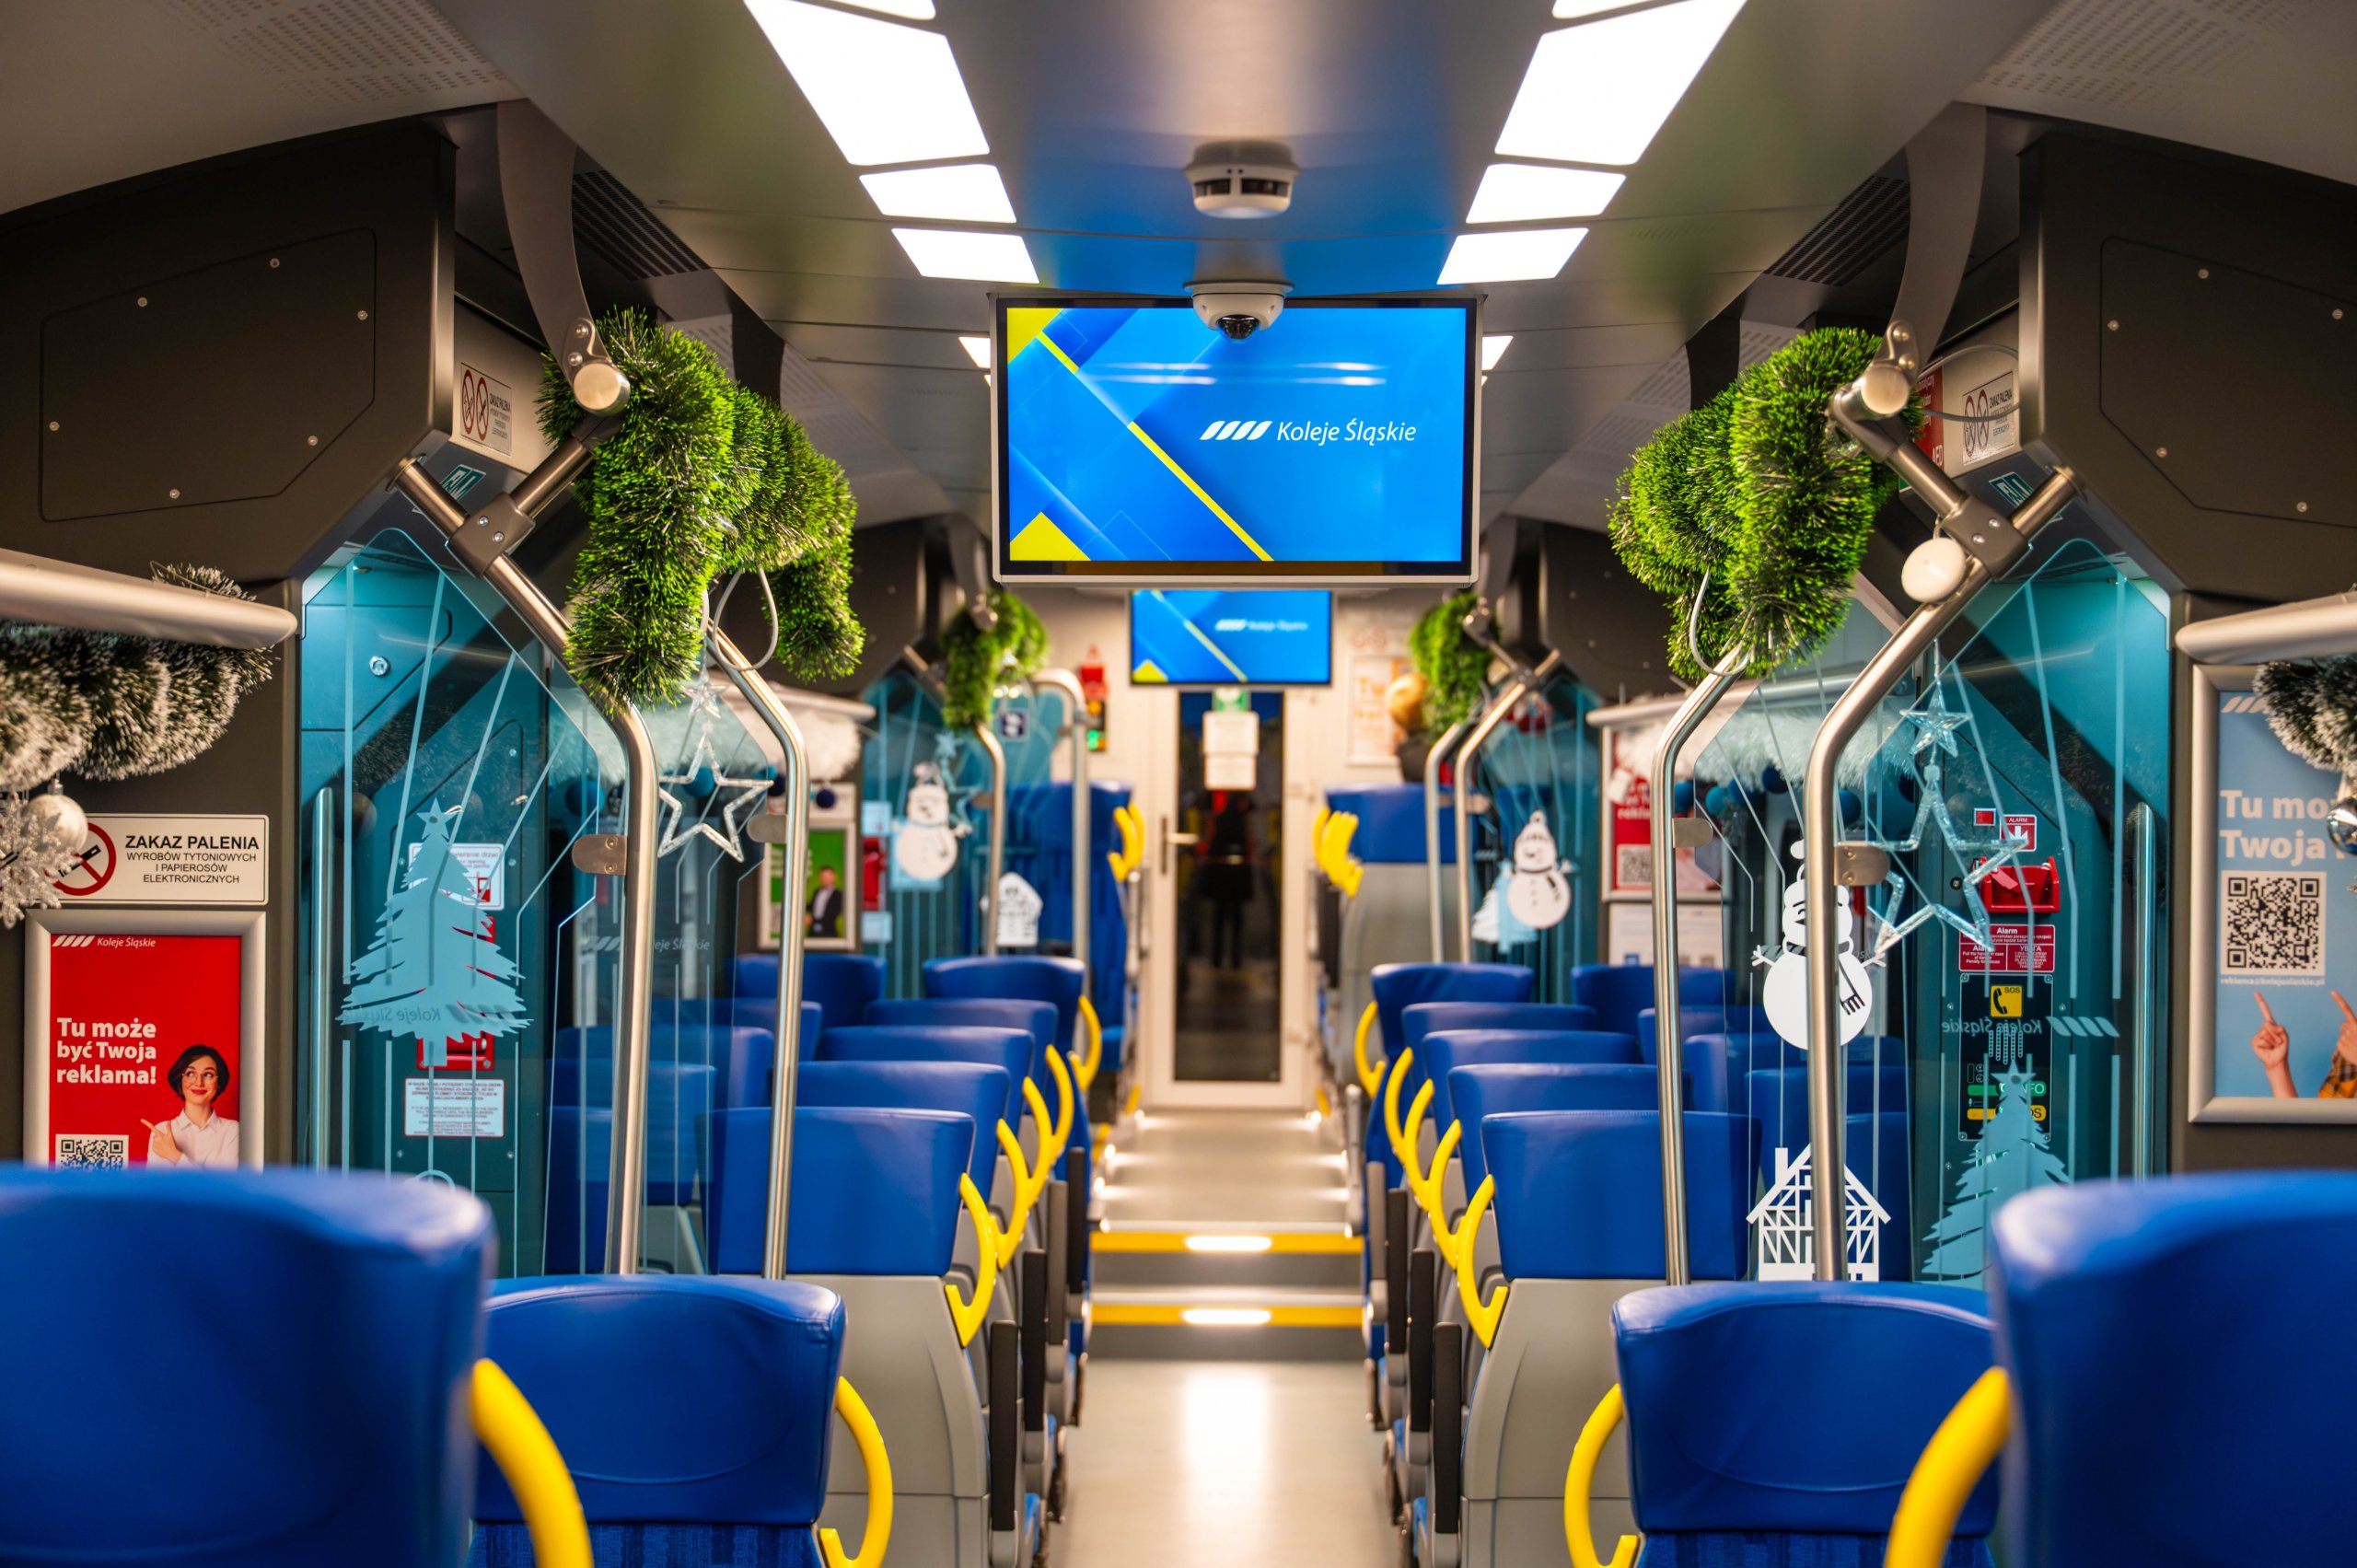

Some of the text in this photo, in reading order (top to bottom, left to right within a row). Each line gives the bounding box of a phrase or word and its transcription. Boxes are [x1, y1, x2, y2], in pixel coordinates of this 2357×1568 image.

[1277, 417, 1417, 447] Koleje Śląskie
[2220, 790, 2263, 819] Tu
[125, 835, 260, 850] ZAKAZ PALENIA
[2219, 830, 2326, 866] Twoja
[126, 851, 257, 862] WYROBÓW TYTONIOWYCH
[143, 874, 240, 883] ELEKTRONICZNYCH
[156, 863, 228, 873] I PAPIEROSÓW
[97, 935, 157, 949] Koleje Śląskie
[57, 1017, 157, 1039] Tu może
[56, 1040, 157, 1063] być Twoja
[56, 1063, 157, 1085] reklama!
